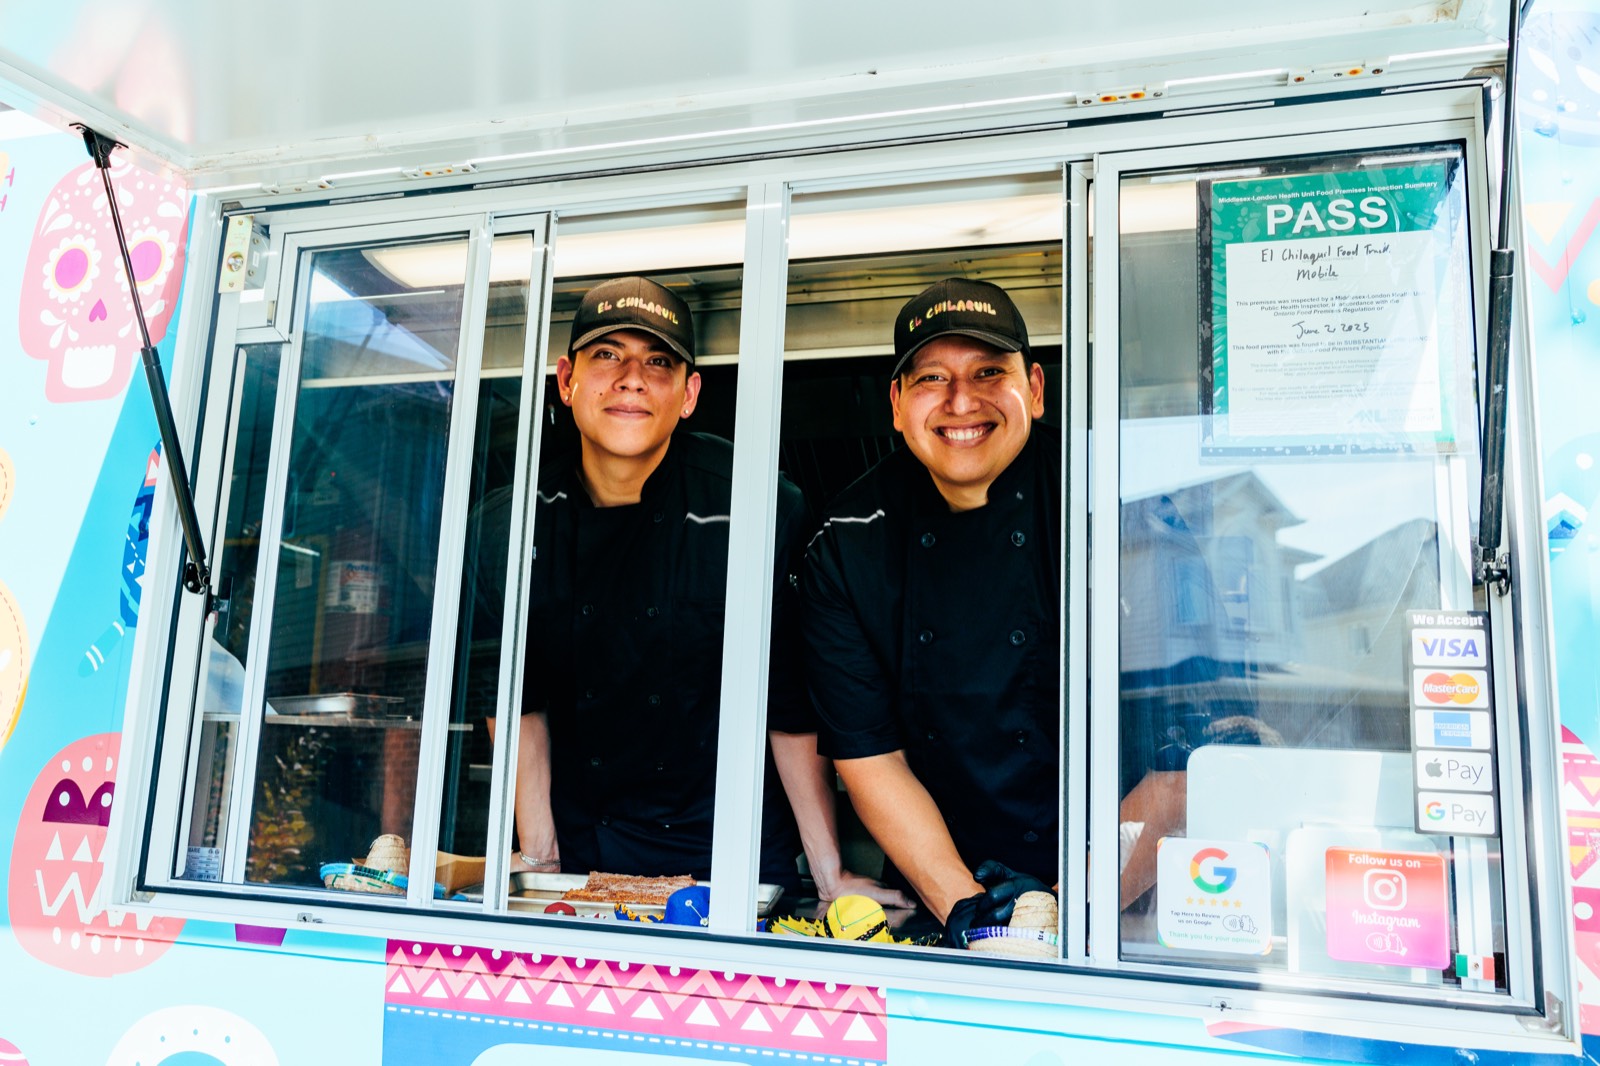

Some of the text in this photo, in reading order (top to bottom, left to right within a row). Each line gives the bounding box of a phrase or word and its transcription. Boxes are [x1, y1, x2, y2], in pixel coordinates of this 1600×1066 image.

[1218, 181, 1438, 204] Middlesex-London Health Unit Food Premises Inspection Summary
[1266, 196, 1389, 236] PASS
[1261, 248, 1274, 263] El
[1281, 244, 1331, 266] Chilaquil
[1336, 243, 1359, 257] Food
[1296, 264, 1339, 282] Mobile
[1249, 299, 1276, 307] premises
[1291, 296, 1320, 304] inspected
[1335, 293, 1391, 301] Middesex-London
[1301, 301, 1330, 309] Inspector,
[1313, 307, 1341, 315] Premiss
[1342, 305, 1375, 314] Regulation
[597, 297, 679, 325] EL CHILAQUIL
[908, 299, 997, 333] EL CHILAQUIL
[1291, 320, 1320, 340] June
[1340, 321, 1370, 333] 2025
[1260, 342, 1288, 350] premises
[1331, 344, 1360, 352] Premises
[1412, 614, 1484, 627] We Accept
[1419, 637, 1479, 658] VISA
[1423, 682, 1479, 695] MasterCard
[1447, 759, 1484, 785] Pay
[1451, 803, 1487, 827] Pay
[1189, 847, 1237, 894] G
[1348, 854, 1421, 869] Follow us on
[1352, 910, 1421, 932] Instagram
[1168, 930, 1189, 939] Thank
[1190, 933, 1203, 941] you
